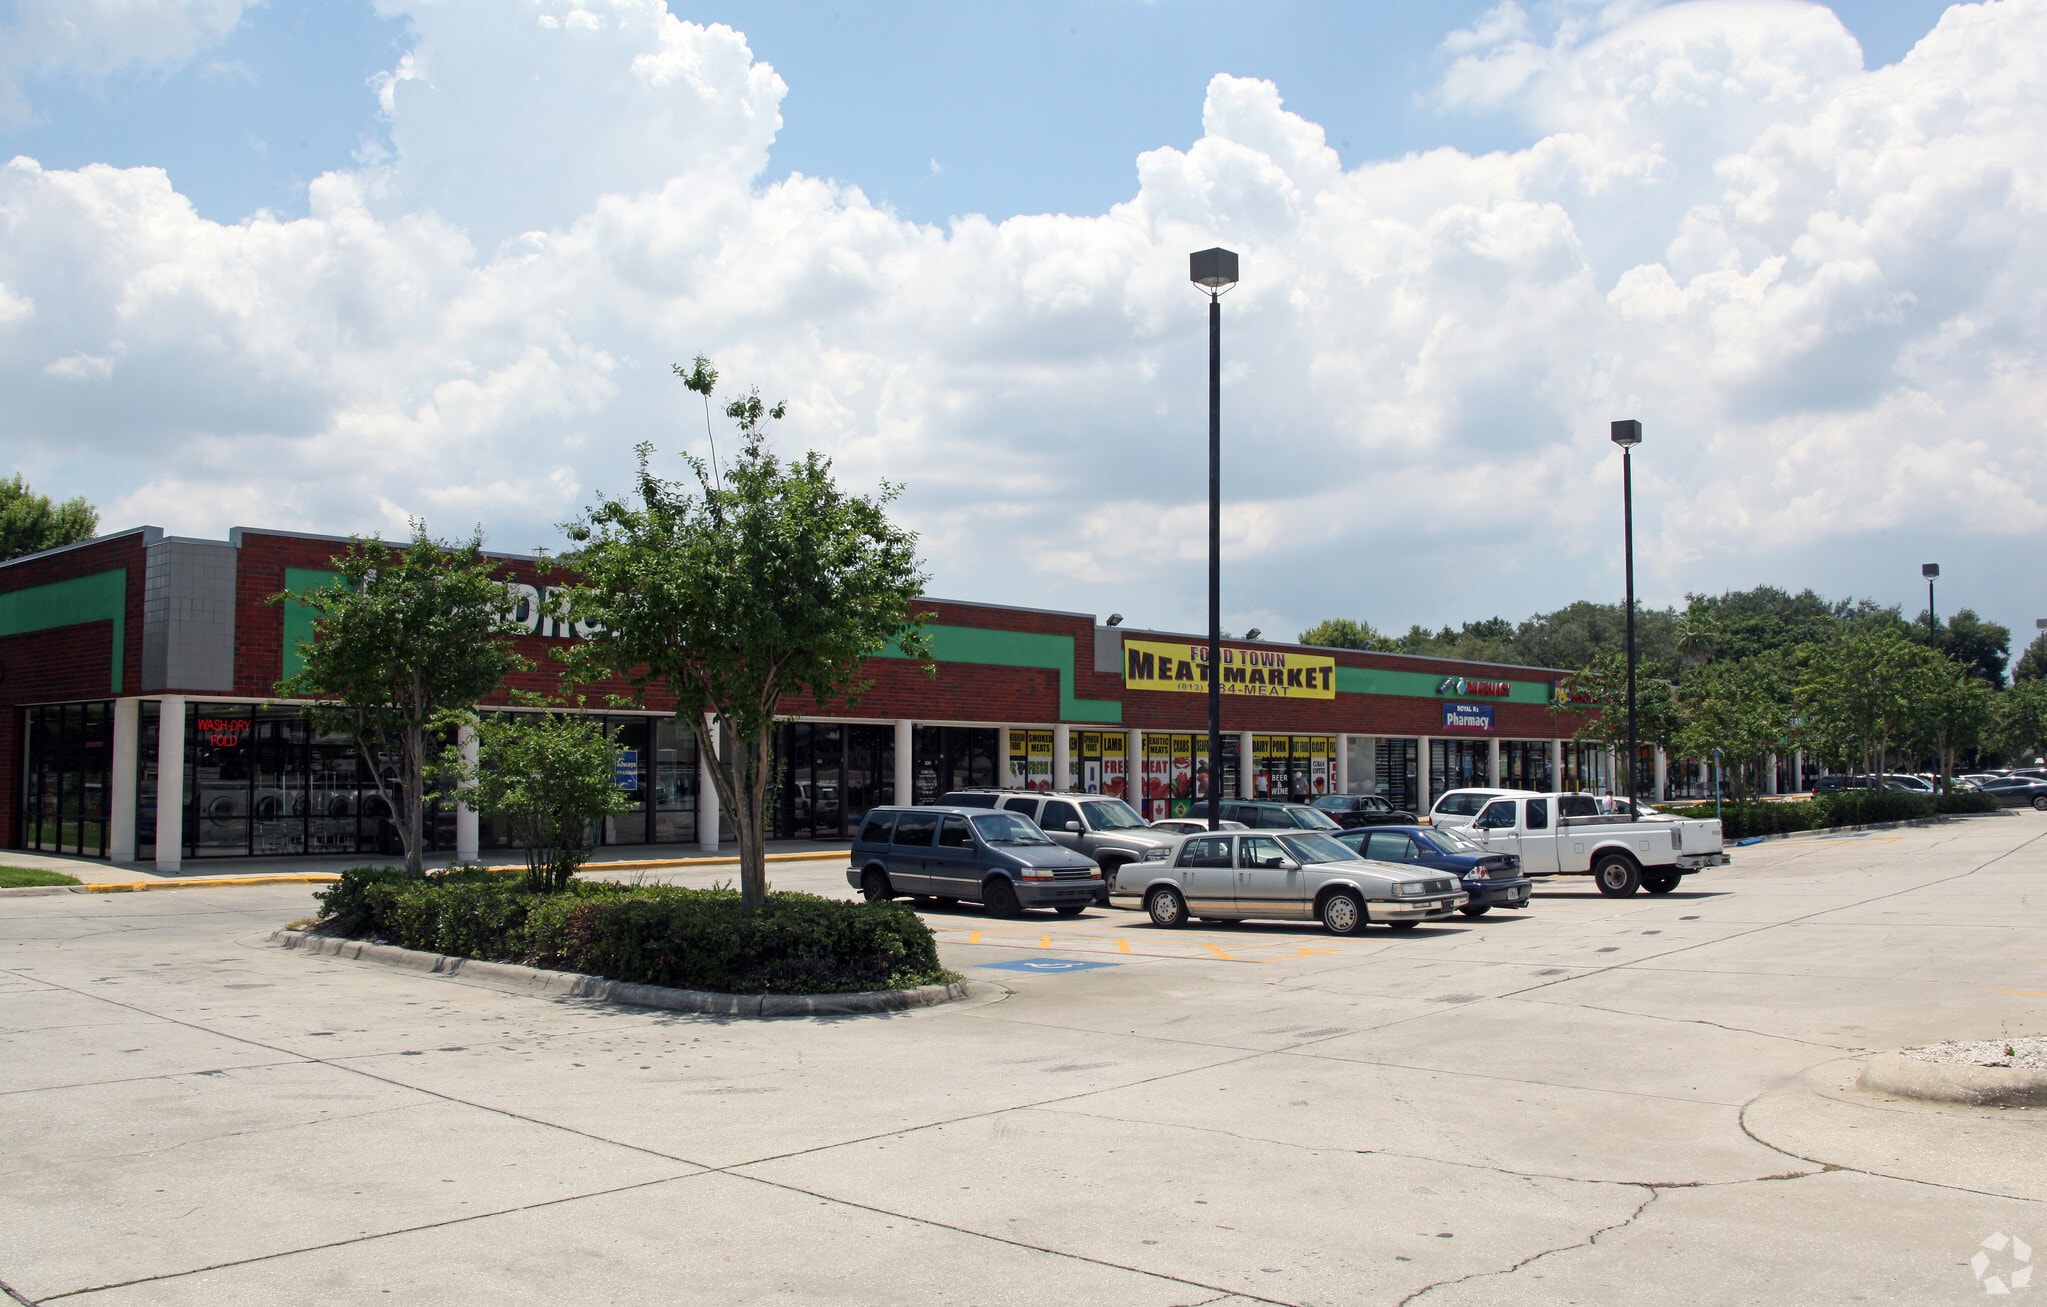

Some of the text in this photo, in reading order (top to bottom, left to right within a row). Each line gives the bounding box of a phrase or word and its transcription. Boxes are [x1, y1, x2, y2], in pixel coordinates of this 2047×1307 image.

[1190, 645, 1286, 668] FOD TOWN
[1128, 648, 1333, 691] MEAT MARKET
[1177, 683, 1203, 692] (813)
[1466, 680, 1512, 698] PHARMACY
[1456, 705, 1472, 713] ROYAL
[197, 719, 252, 731] WASH-DRY
[1447, 713, 1490, 730] Pharmacy
[210, 734, 238, 747] FOLD
[1104, 738, 1123, 751] LAMB
[1149, 737, 1169, 746] EXOTIC
[1173, 739, 1189, 752] CRABS
[1031, 743, 1050, 752] MEATS
[1085, 743, 1098, 752] FOODS
[1150, 746, 1169, 754] MEATS
[1252, 741, 1270, 753] DAIRY
[1272, 741, 1287, 753] PORK
[1311, 741, 1326, 753] GOAT
[1271, 787, 1288, 795] WINE
